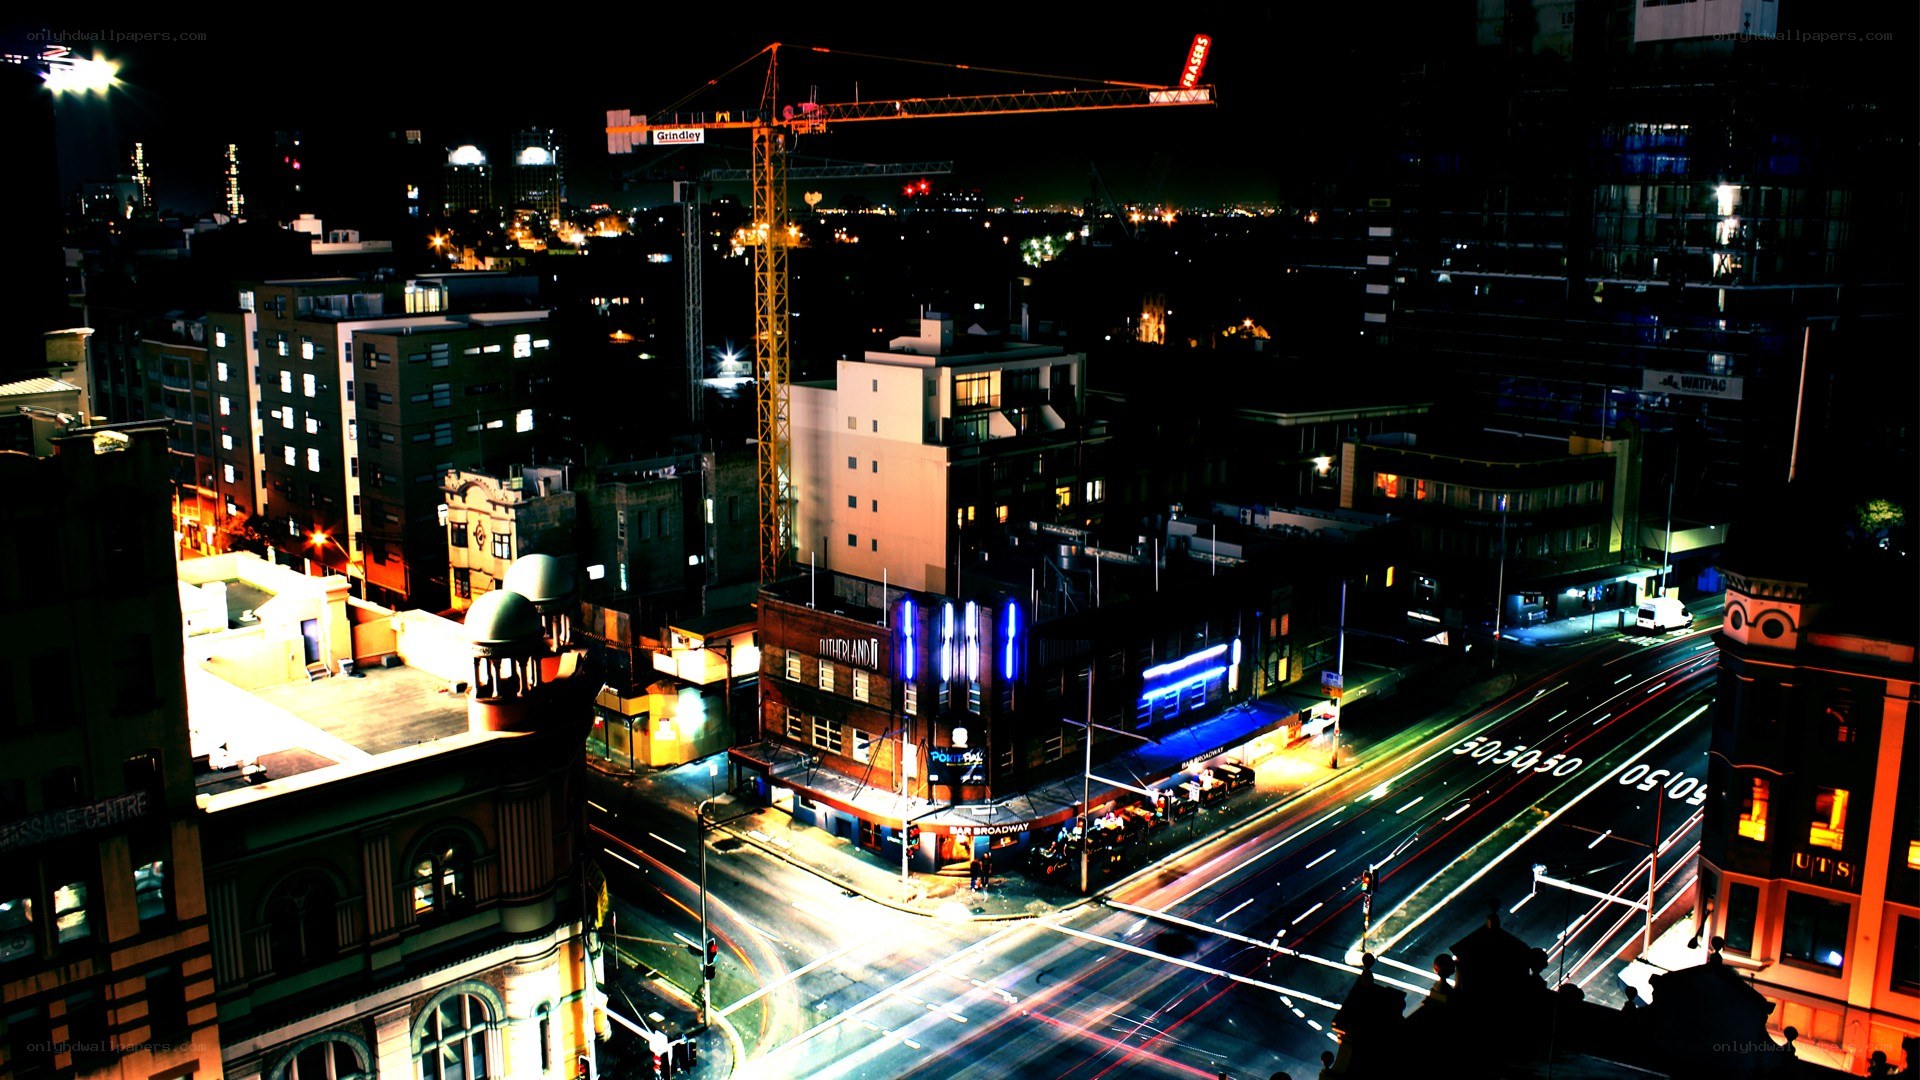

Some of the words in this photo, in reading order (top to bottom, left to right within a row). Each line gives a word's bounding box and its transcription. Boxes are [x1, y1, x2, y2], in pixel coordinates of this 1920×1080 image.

[1183, 37, 1208, 87] FRASERS
[657, 131, 701, 141] Grindley
[1681, 375, 1726, 392] WATPAC
[84, 792, 148, 830] CENTRE
[949, 825, 971, 835] BAR
[973, 823, 1029, 835] BROADWAY
[1796, 853, 1850, 877] UTS
